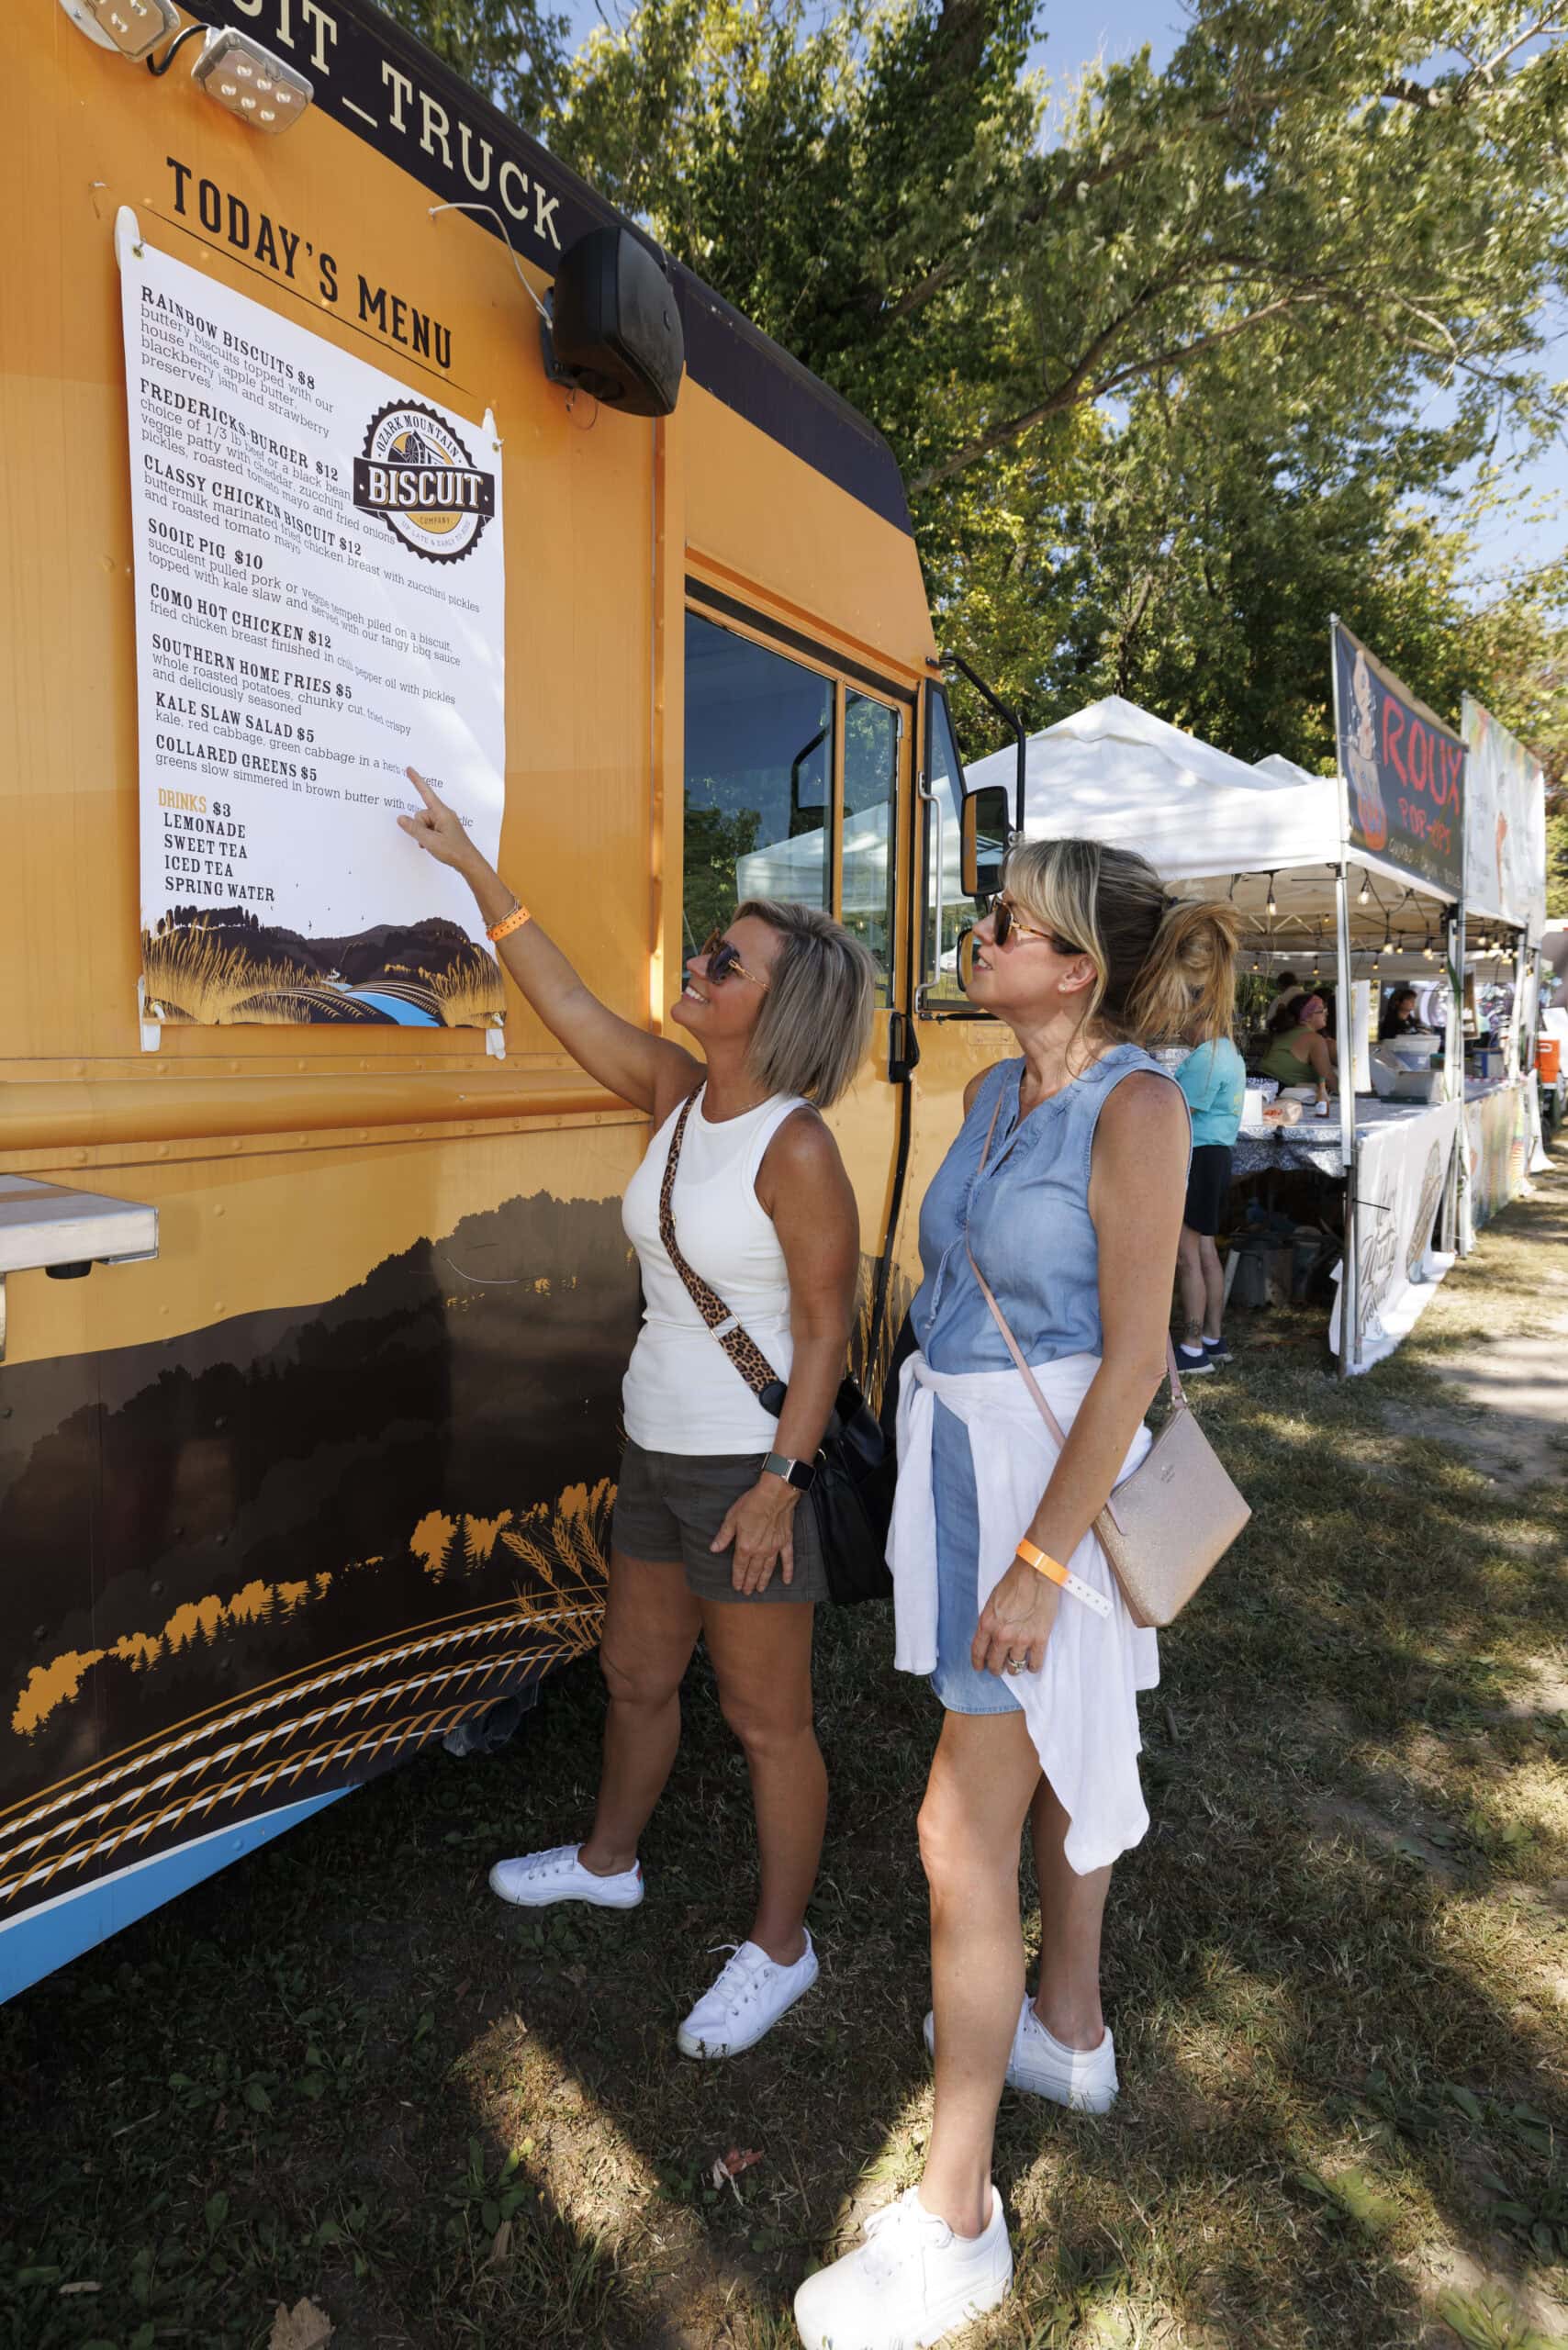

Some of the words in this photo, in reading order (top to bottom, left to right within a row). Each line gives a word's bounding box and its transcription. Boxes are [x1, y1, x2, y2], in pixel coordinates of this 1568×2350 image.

[166, 155, 338, 303] TODAY'S
[357, 274, 452, 369] MENU
[140, 285, 218, 339] RAINBOW
[222, 330, 295, 379] BISCUITS
[297, 371, 315, 390] $8
[140, 319, 185, 347] house
[189, 342, 219, 368] made
[223, 365, 257, 389] apple
[140, 304, 190, 338] buttery
[195, 330, 241, 365] biscuits
[244, 359, 284, 387] topped
[288, 383, 312, 403] with
[315, 396, 334, 413] our
[140, 334, 214, 379] blackberry
[218, 374, 239, 394] jam
[241, 386, 264, 408] and
[268, 400, 330, 438] strawberry
[140, 397, 183, 425] choice
[187, 418, 201, 431] of
[206, 423, 227, 440] 1/3
[231, 432, 241, 446] lb
[268, 456, 279, 471] or
[282, 464, 289, 475] a
[293, 466, 321, 490] black
[326, 483, 352, 500] bean
[140, 414, 183, 441] veggie
[187, 432, 221, 453] patty
[226, 446, 252, 466] with
[299, 487, 344, 512] zucchini
[376, 417, 405, 453] OZARK
[404, 414, 460, 458] MOUNTAIN
[193, 450, 243, 476] roasted
[247, 468, 279, 494] tomato
[282, 490, 309, 510] mayo
[313, 506, 333, 520] and
[336, 510, 360, 532] fried
[363, 524, 396, 545] onions
[316, 461, 339, 481] $12
[368, 465, 483, 509] BISCUIT
[144, 454, 207, 492] CLASSY
[212, 481, 281, 519] CHICKEN
[284, 512, 336, 546] BISCUIT
[339, 537, 362, 556] $12
[144, 489, 168, 508] and
[172, 498, 220, 526] roasted
[224, 518, 271, 542] tomato
[274, 534, 301, 554] mayo
[144, 471, 208, 507] buttermilk
[213, 500, 278, 531] marinated
[281, 523, 301, 544] fried
[304, 539, 343, 563] chicken
[347, 555, 380, 576] breast
[383, 569, 405, 586] with
[407, 578, 446, 600] zucchini
[448, 594, 480, 613] pickles
[148, 518, 196, 549] SOOIE
[199, 537, 226, 560] PIG
[234, 550, 263, 570] $10
[148, 537, 206, 567] succulent
[209, 560, 248, 581] pulled
[252, 573, 282, 590] pork
[286, 581, 298, 594] or
[330, 603, 364, 625] tempeh
[367, 618, 391, 633] piled
[395, 628, 408, 640] on
[410, 632, 417, 641] a
[148, 551, 190, 577] topped
[194, 568, 219, 588] with
[223, 576, 249, 596] kale
[252, 588, 282, 604] slaw
[286, 595, 308, 611] and
[341, 621, 359, 635] with
[362, 630, 379, 642] our
[382, 633, 409, 653] tangy
[413, 644, 431, 658] bbq
[434, 651, 461, 666] sauce
[151, 583, 193, 610] COMO
[197, 599, 228, 621] HOT
[231, 610, 304, 642] CHICKEN
[308, 630, 331, 649] $12
[150, 600, 177, 621] fried
[182, 612, 228, 636] chicken
[231, 626, 268, 648] breast
[272, 638, 320, 660] finished
[324, 653, 334, 664] in
[385, 677, 397, 689] oil
[399, 682, 420, 696] with
[422, 688, 456, 705] pickles
[152, 633, 235, 671] SOUTHERN
[240, 659, 280, 684] HOME
[284, 671, 331, 695] FRIES
[336, 683, 353, 700] $5
[152, 667, 175, 684] and
[179, 671, 244, 703] deliciously
[248, 693, 302, 716] seasoned
[152, 653, 189, 673] whole
[193, 663, 238, 686] roasted
[297, 691, 344, 712] chunky
[385, 719, 411, 736] crispy
[155, 691, 196, 716] KALE
[200, 703, 241, 726] SLAW
[245, 714, 293, 738] SALAD
[297, 726, 315, 743] $5
[156, 734, 237, 765] COLLARED
[241, 753, 297, 778] GREENS
[301, 766, 317, 782] $5
[187, 719, 209, 733] red
[269, 738, 301, 755] green
[304, 744, 356, 766] cabbage
[359, 755, 370, 767] in
[373, 759, 380, 768] a
[1383, 695, 1462, 816] ROUX
[155, 754, 197, 772] greens
[201, 761, 230, 778] slow
[233, 769, 289, 790] simmered
[292, 780, 303, 791] in
[306, 784, 341, 800] brown
[345, 790, 380, 805] butter
[384, 797, 405, 809] with
[158, 788, 207, 814] DRINKS
[213, 801, 231, 818] $3
[164, 812, 246, 839] LEMONADE
[164, 834, 215, 855] SWEET
[219, 842, 248, 859] TEA
[165, 855, 200, 873] ICED
[205, 860, 234, 878] TEA
[165, 877, 223, 896] SPRING
[228, 883, 275, 902] WATER
